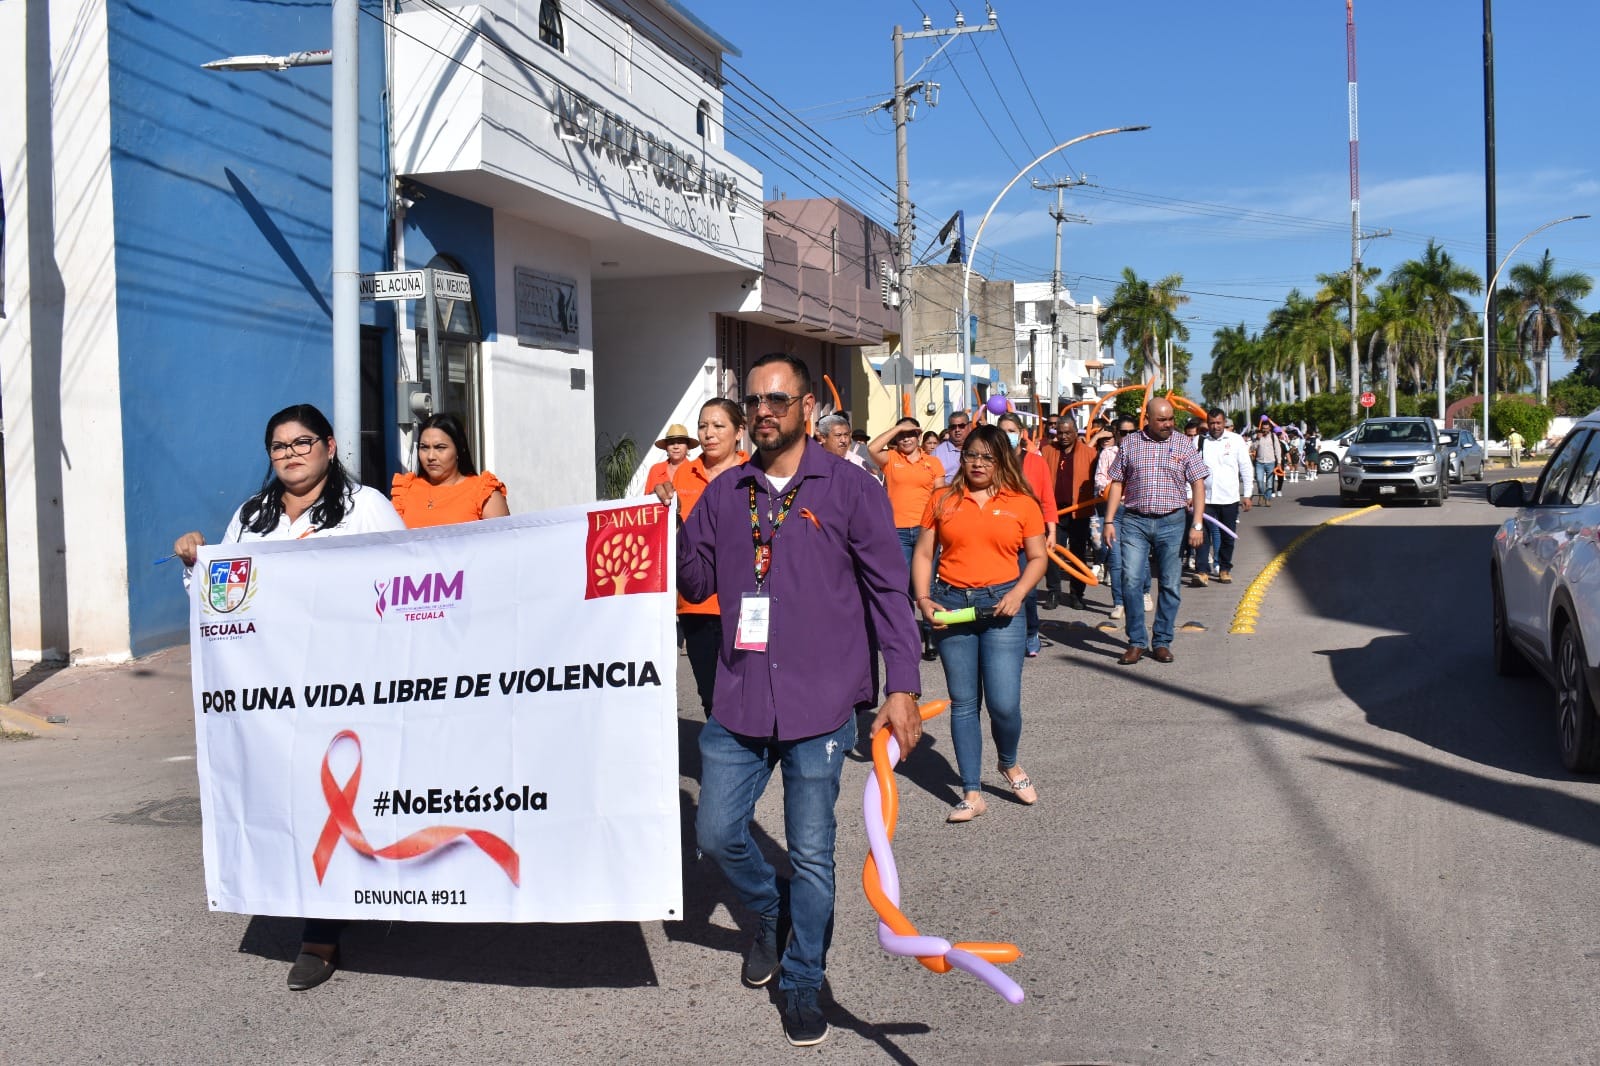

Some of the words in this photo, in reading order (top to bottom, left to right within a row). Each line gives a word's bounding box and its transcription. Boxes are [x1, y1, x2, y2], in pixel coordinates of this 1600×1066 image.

[664, 195, 687, 229] Rico
[359, 279, 387, 295] ANUEL
[388, 275, 421, 293] ACUÑA
[596, 506, 664, 532] PAIMEF
[391, 570, 464, 606] IMM
[200, 622, 256, 637] TECUALA
[405, 611, 445, 622] TECUALA
[202, 689, 236, 714] POR
[242, 686, 296, 711] UNA
[304, 682, 366, 708] VIDA
[373, 676, 448, 705] LIBRE
[454, 673, 491, 699] DE
[498, 660, 662, 696] VIOLENCIA
[372, 785, 548, 817] #NoEstásSola
[354, 889, 428, 905] DENUNCIA
[431, 889, 467, 905] #911
